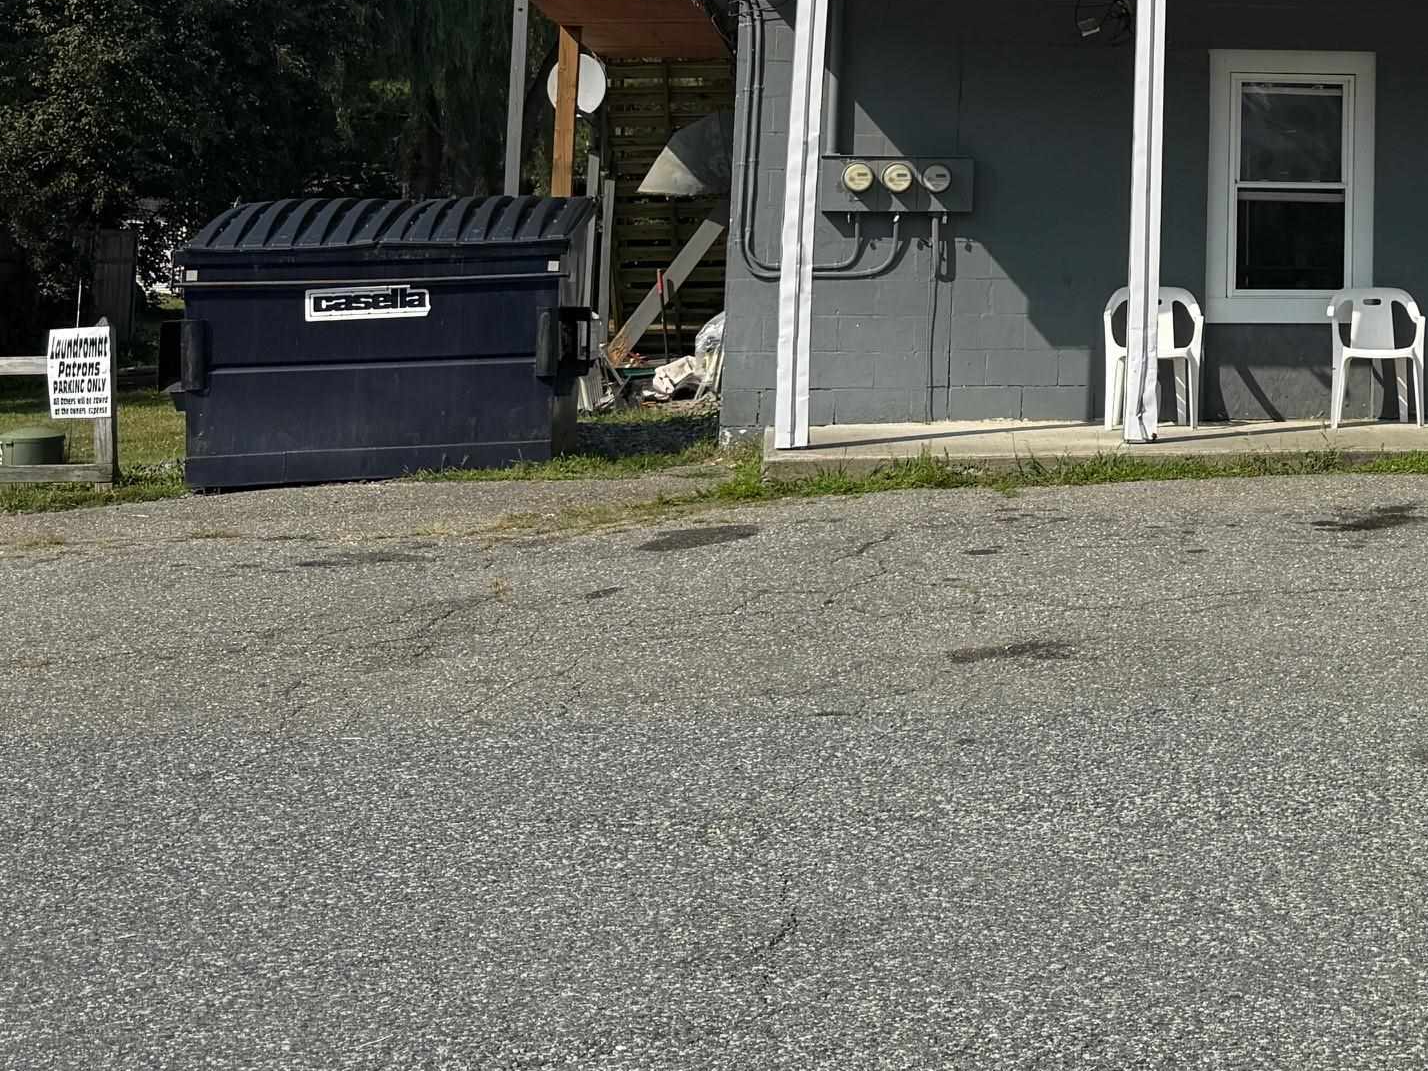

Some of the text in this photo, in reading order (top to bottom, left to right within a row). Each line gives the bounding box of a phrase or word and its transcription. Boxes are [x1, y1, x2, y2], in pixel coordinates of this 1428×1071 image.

[313, 287, 427, 312] casella
[50, 333, 108, 359] Laundromat
[58, 361, 101, 377] Patrons
[53, 378, 106, 394] PARKING ONLY
